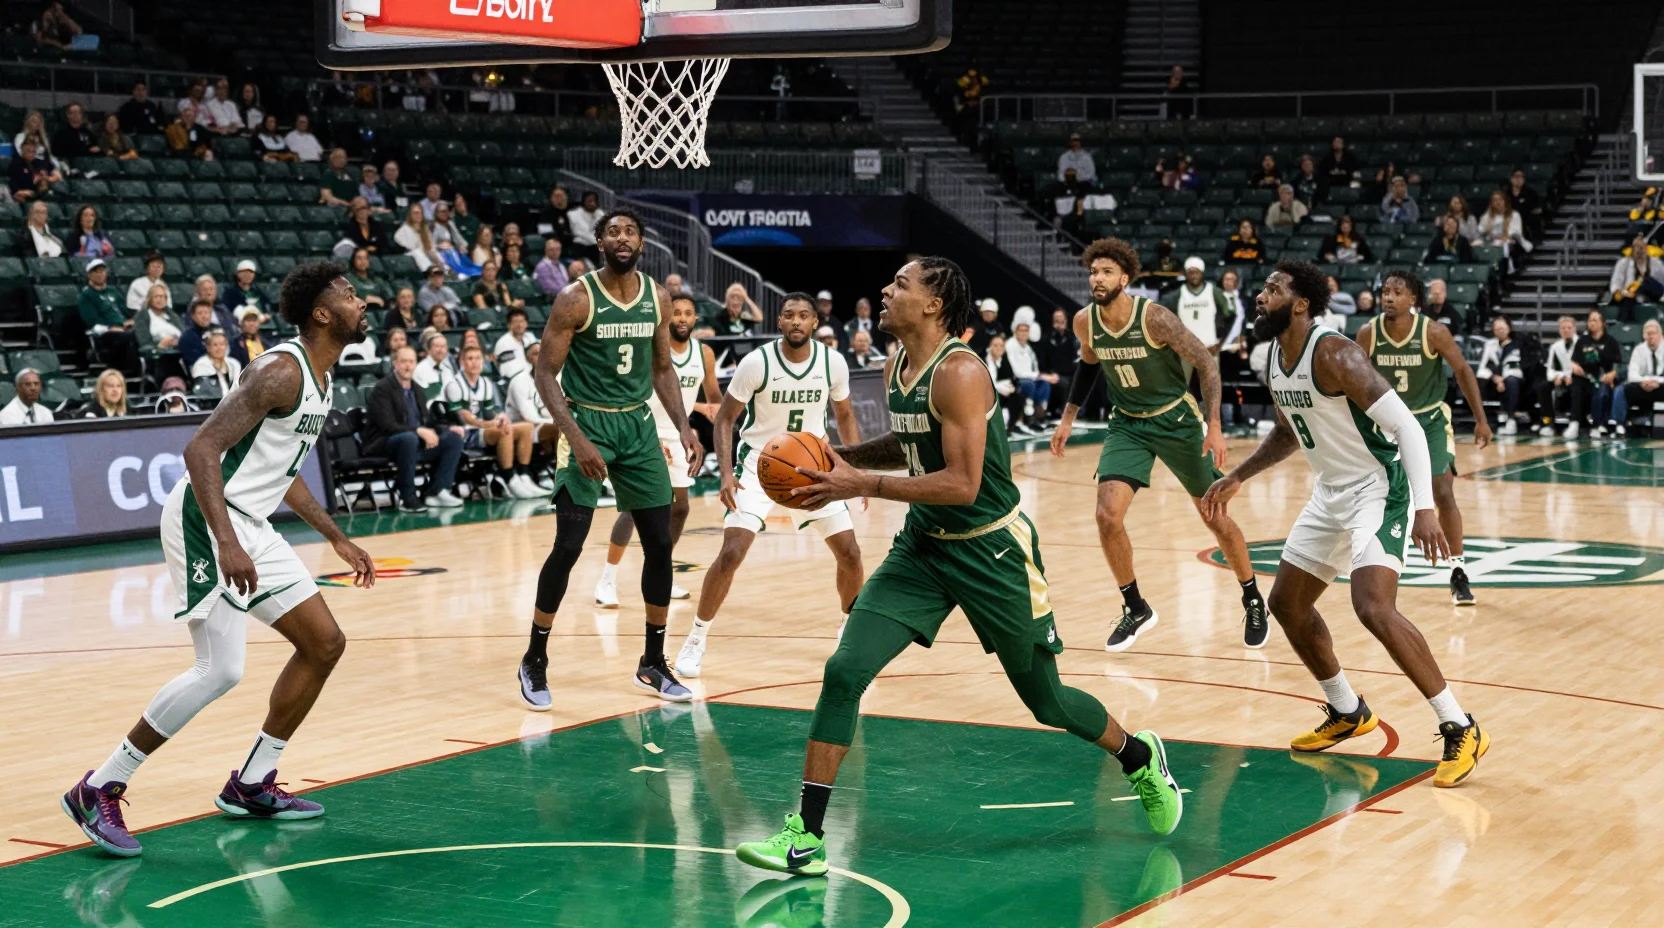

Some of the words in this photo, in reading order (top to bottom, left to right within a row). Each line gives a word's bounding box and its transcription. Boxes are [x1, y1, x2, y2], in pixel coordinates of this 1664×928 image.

[616, 343, 634, 375] 3
[1114, 364, 1140, 388] 10
[786, 409, 805, 433] 5
[0, 465, 43, 522] L
